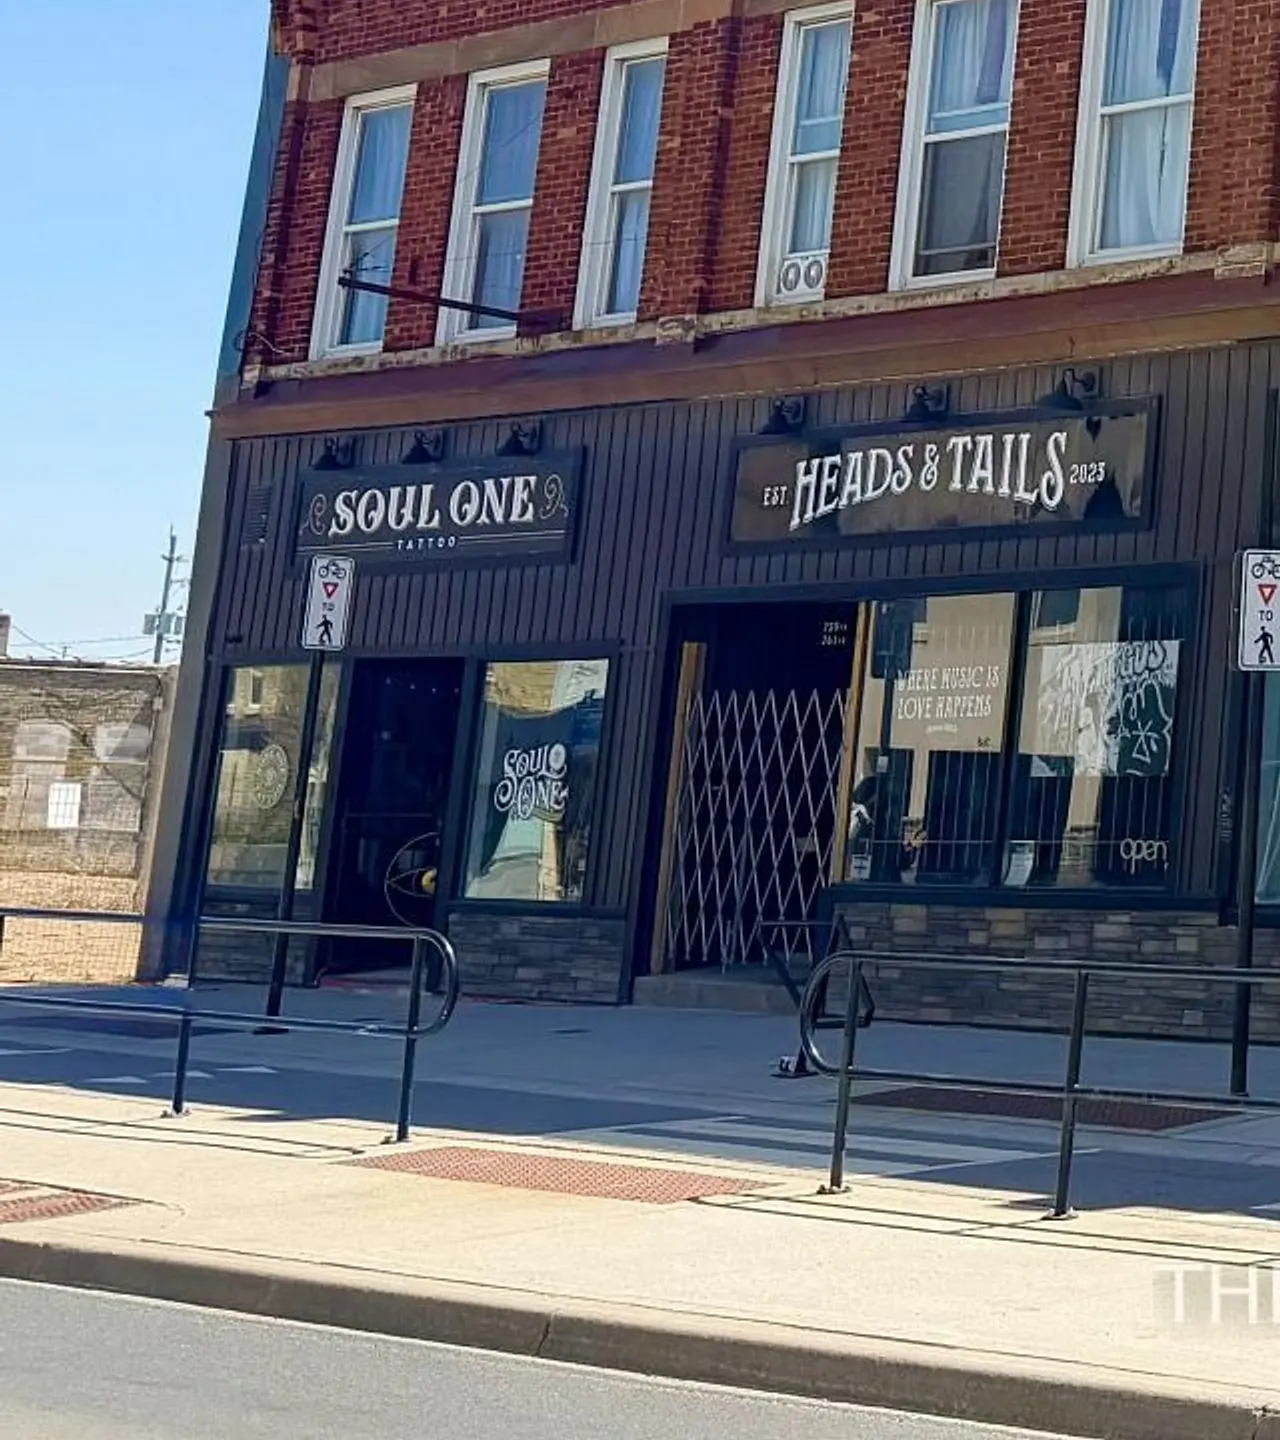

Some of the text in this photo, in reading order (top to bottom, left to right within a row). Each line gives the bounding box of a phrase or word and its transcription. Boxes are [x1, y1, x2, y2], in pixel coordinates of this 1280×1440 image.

[763, 485, 790, 507] EST.
[789, 445, 914, 532] HEADS
[919, 443, 940, 490] &
[946, 431, 1068, 511] TAILS
[328, 474, 538, 537] SOUL ONE
[397, 536, 457, 550] TATTOO
[1257, 610, 1274, 621] TO
[940, 665, 984, 690] MUSIC
[986, 664, 1000, 688] IS
[897, 694, 992, 720] LOVE HAPPENS
